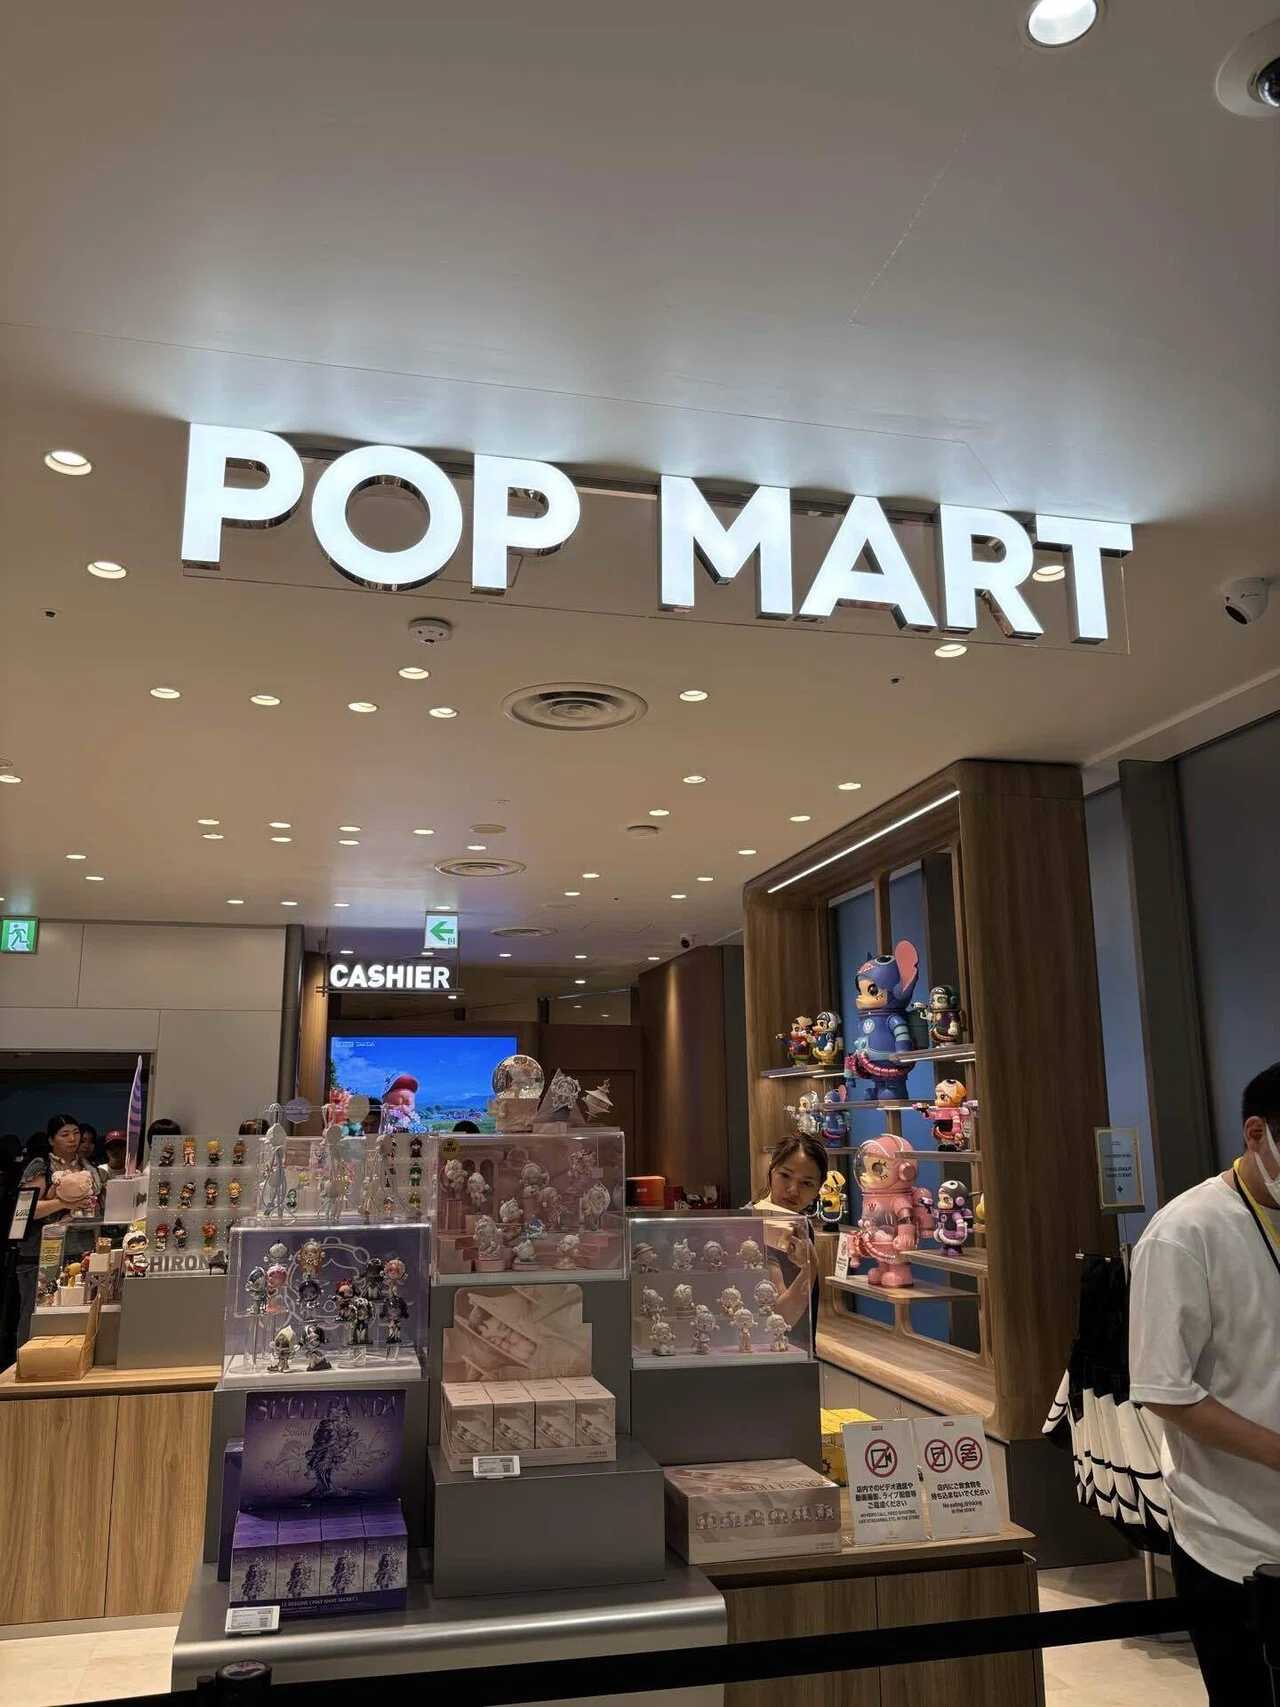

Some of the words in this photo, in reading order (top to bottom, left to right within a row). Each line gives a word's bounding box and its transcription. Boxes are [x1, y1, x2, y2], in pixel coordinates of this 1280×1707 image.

[181, 423, 581, 594] POP
[659, 474, 1133, 645] MART
[330, 964, 450, 988] CASHIER
[150, 1255, 209, 1272] HIRON
